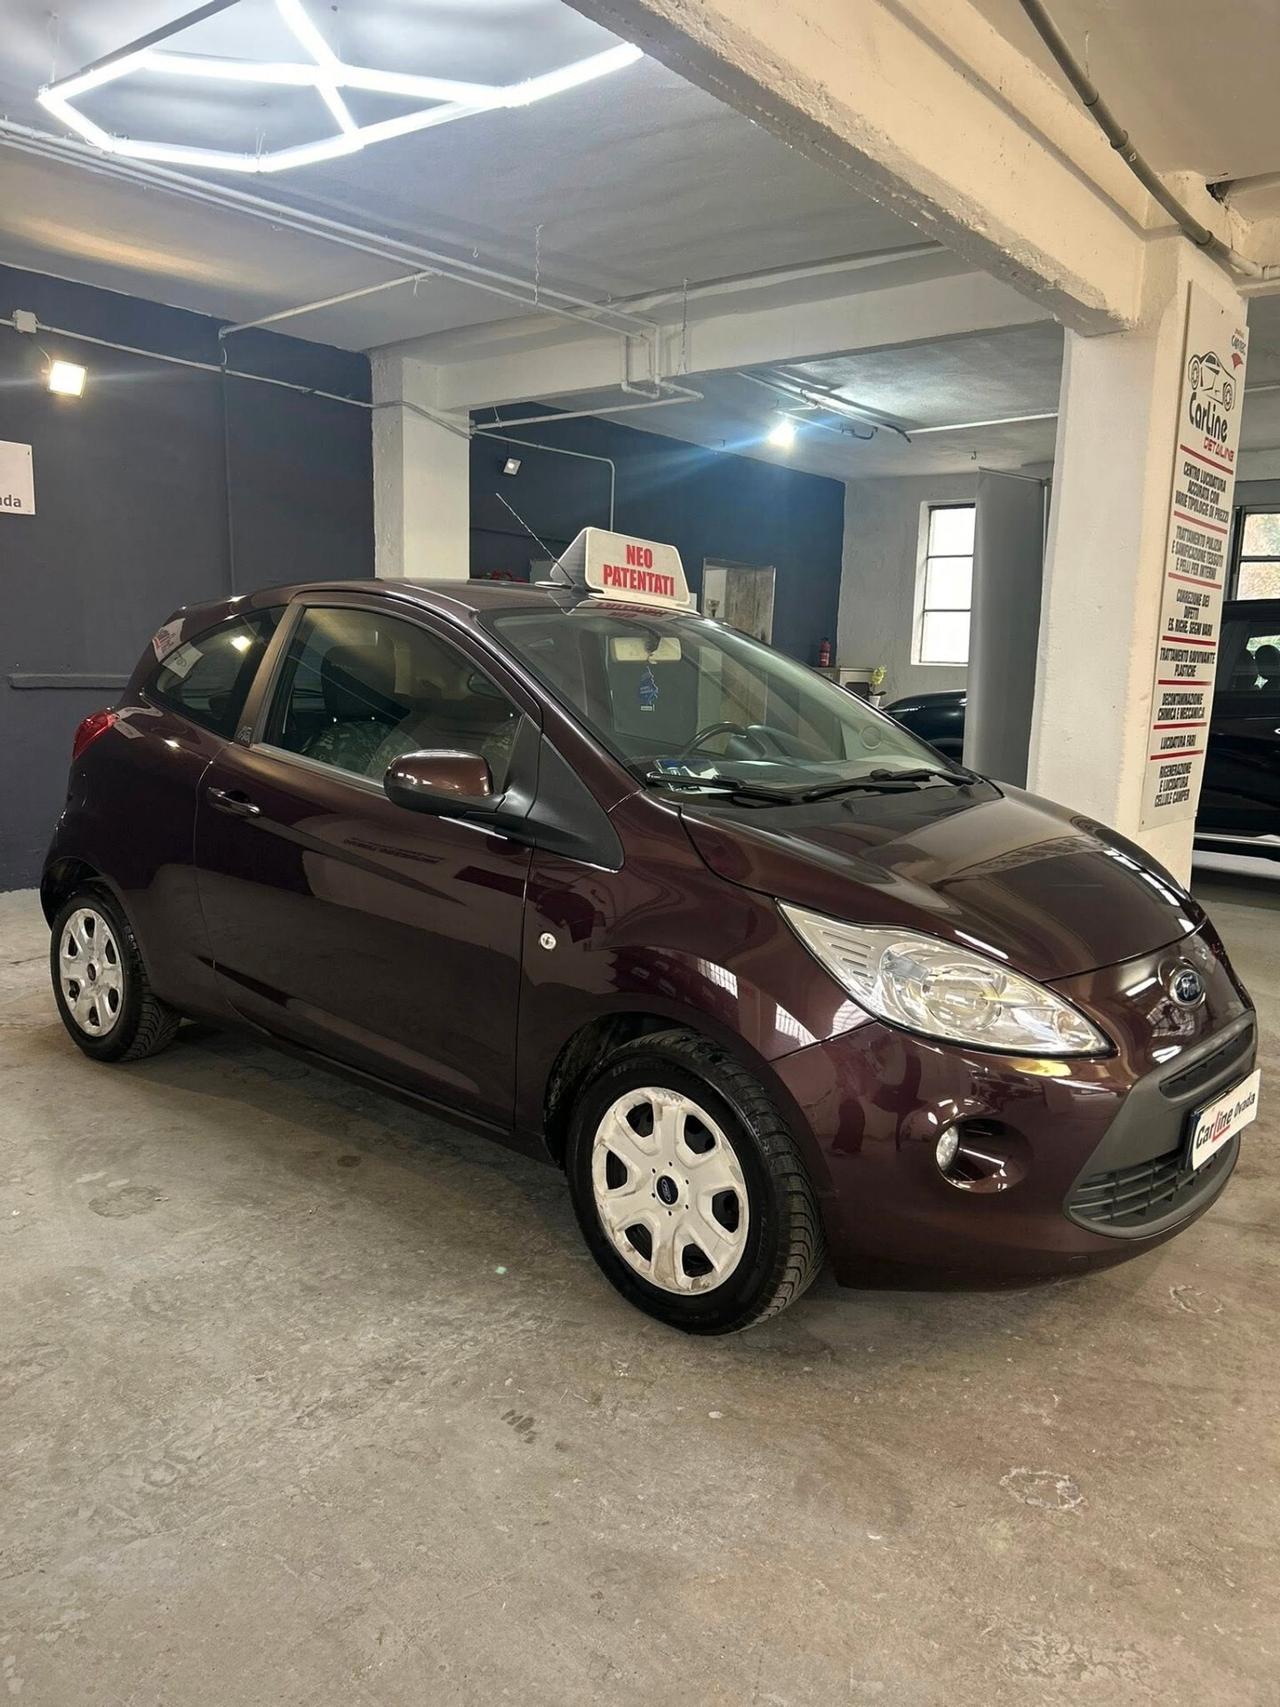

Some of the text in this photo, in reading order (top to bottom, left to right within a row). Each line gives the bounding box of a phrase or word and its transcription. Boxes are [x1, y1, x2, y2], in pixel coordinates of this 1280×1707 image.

[1184, 461, 1226, 493] CENTRO LUCIDATURA
[1176, 525, 1205, 547] TRATTAMENTO
[626, 544, 653, 569] NEO
[603, 564, 675, 597] PATENTATI
[1202, 595, 1210, 607] DEI
[1160, 647, 1189, 662] TRATTAMENTO
